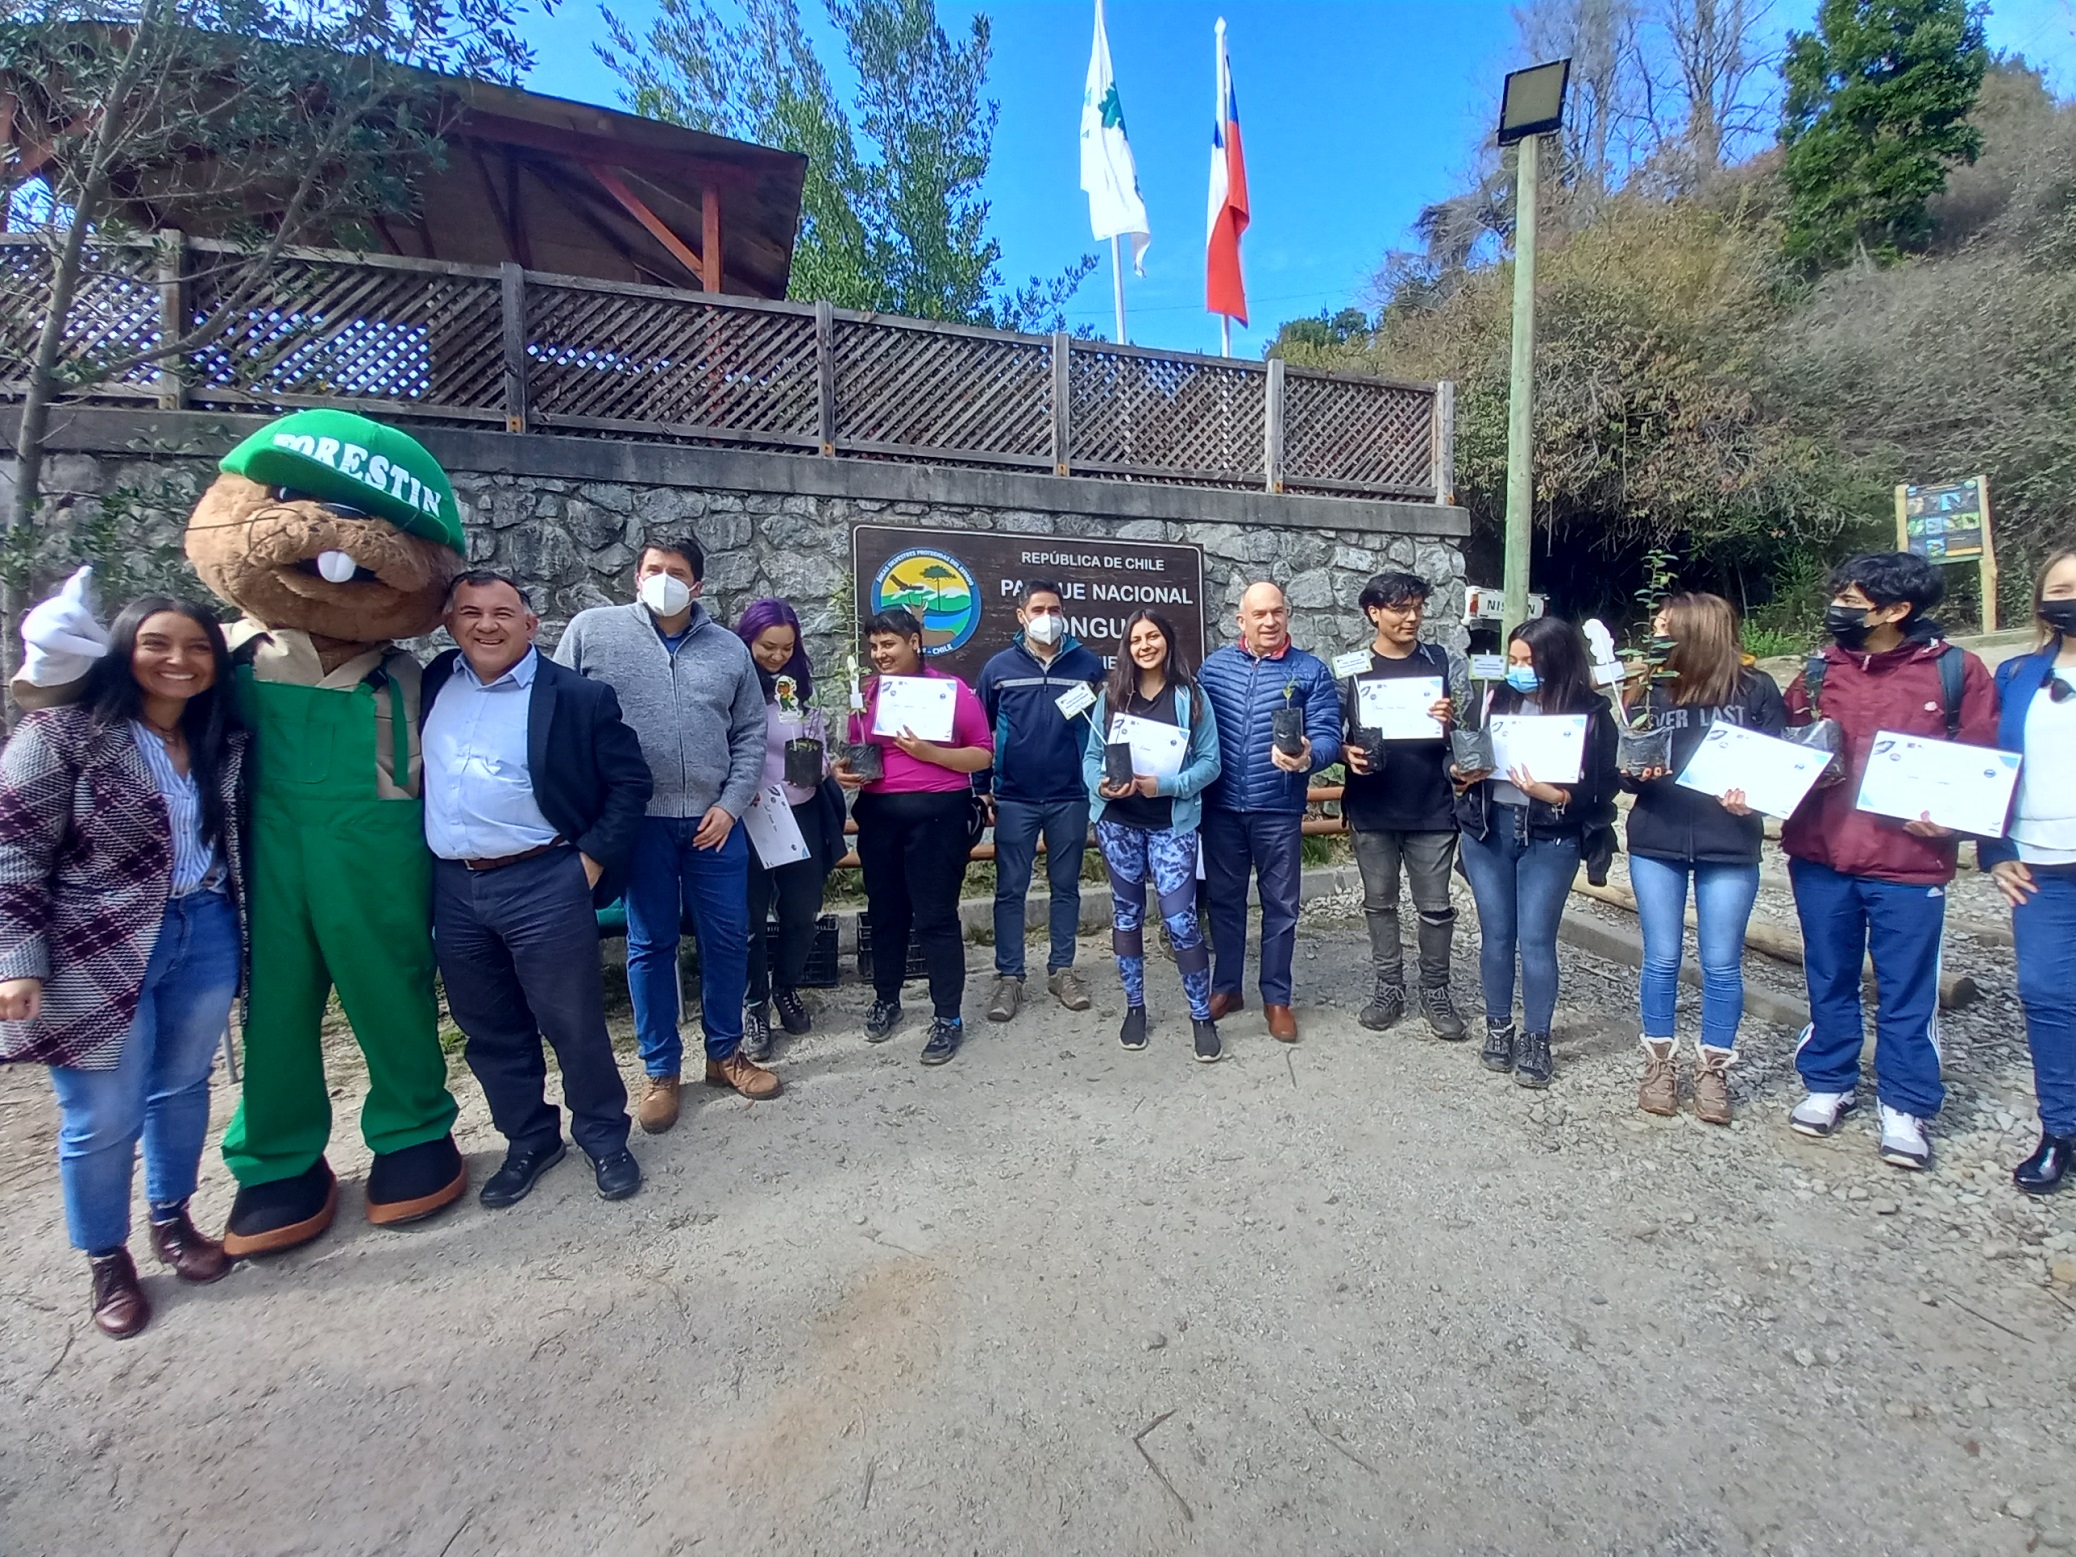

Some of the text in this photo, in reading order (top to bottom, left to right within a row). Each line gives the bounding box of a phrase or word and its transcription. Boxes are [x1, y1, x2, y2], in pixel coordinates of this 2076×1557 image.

[1021, 550, 1165, 571] REPÚBLICA DE CHILE
[1001, 579, 1194, 605] PAUE NACIONAL
[1487, 599, 1536, 615] NIN
